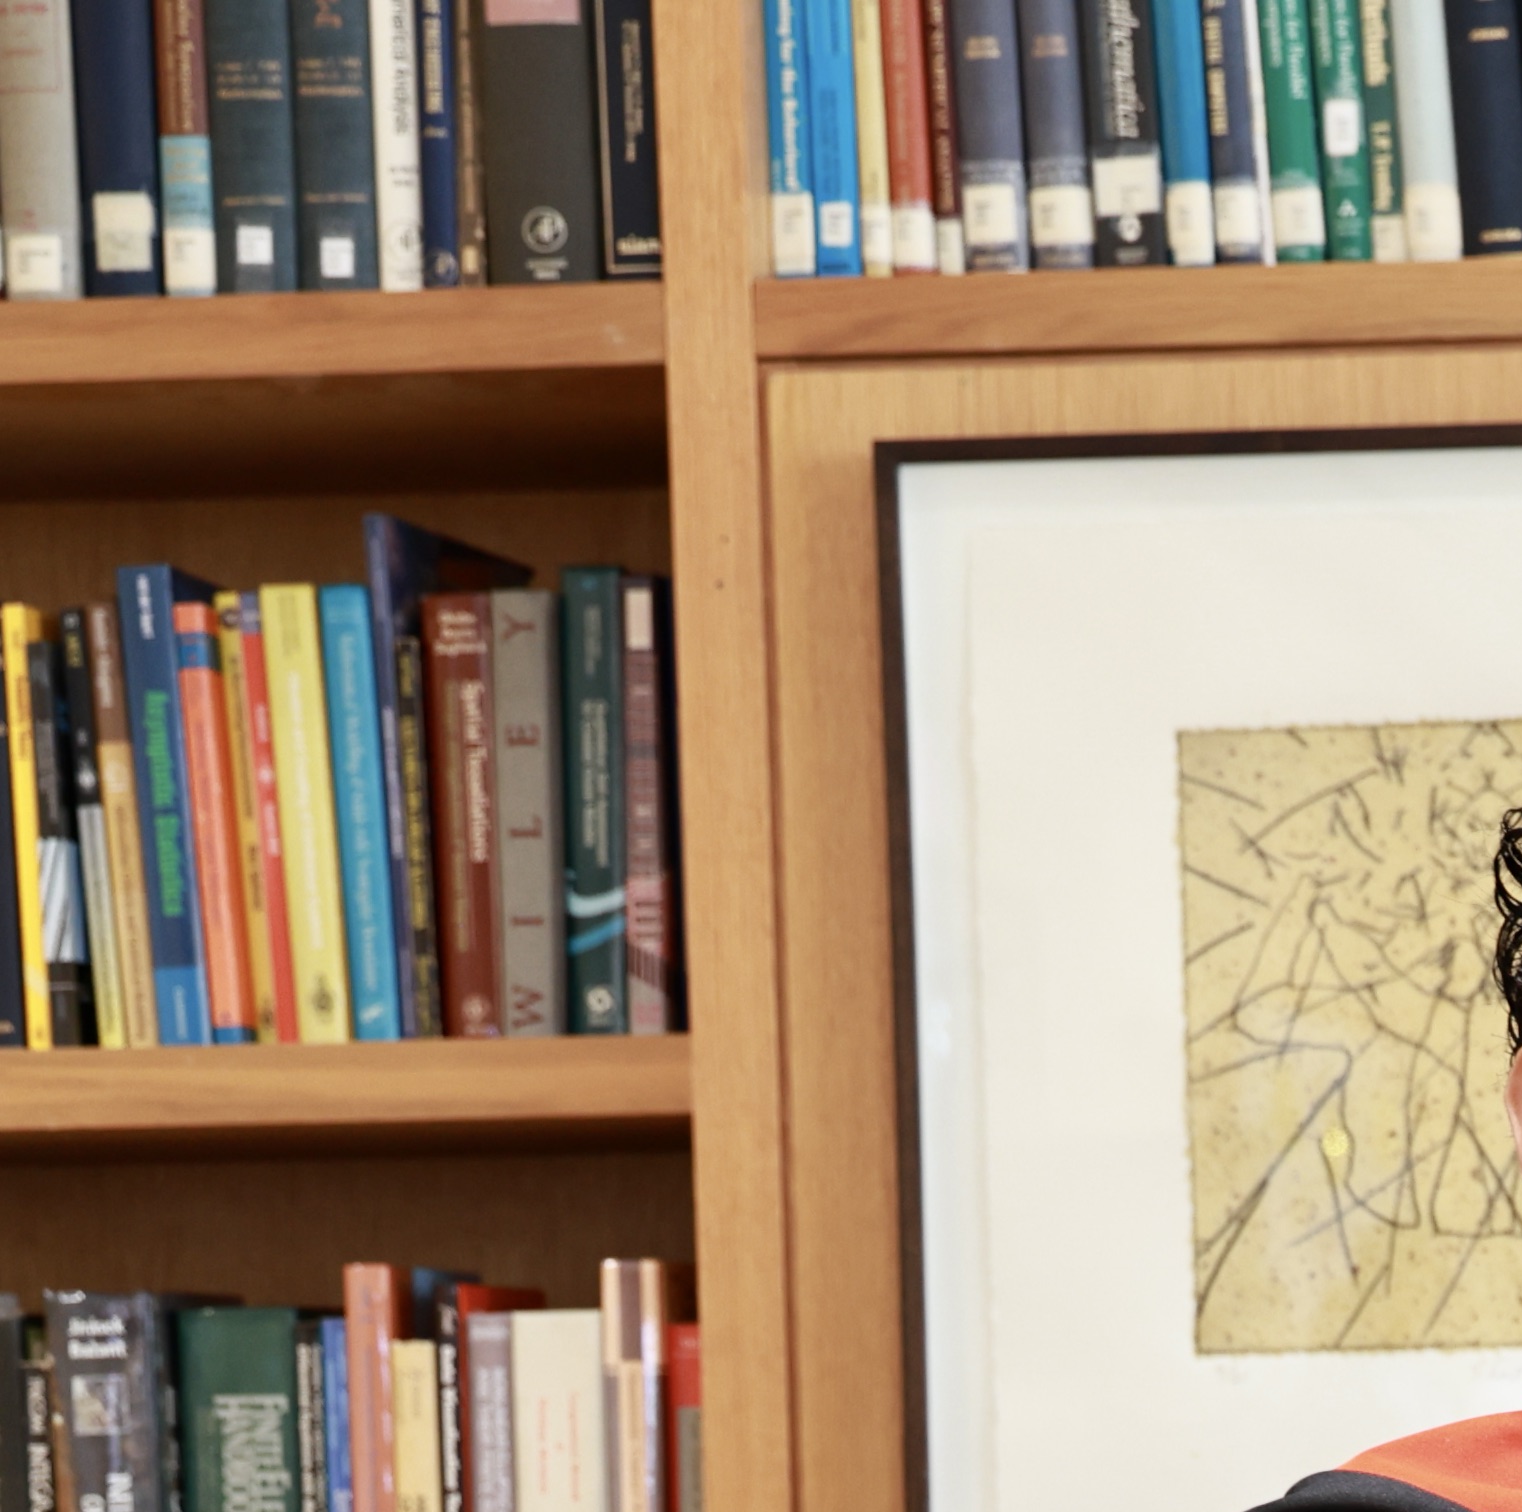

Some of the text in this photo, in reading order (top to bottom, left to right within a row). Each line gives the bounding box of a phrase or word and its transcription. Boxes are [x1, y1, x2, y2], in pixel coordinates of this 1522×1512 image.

[391, 0, 411, 60] merical
[1113, 0, 1144, 137] thematica
[142, 689, 186, 917] Asymptotic Statistics
[459, 680, 491, 863] Spatial Tessellations
[502, 613, 546, 1028] WILEY
